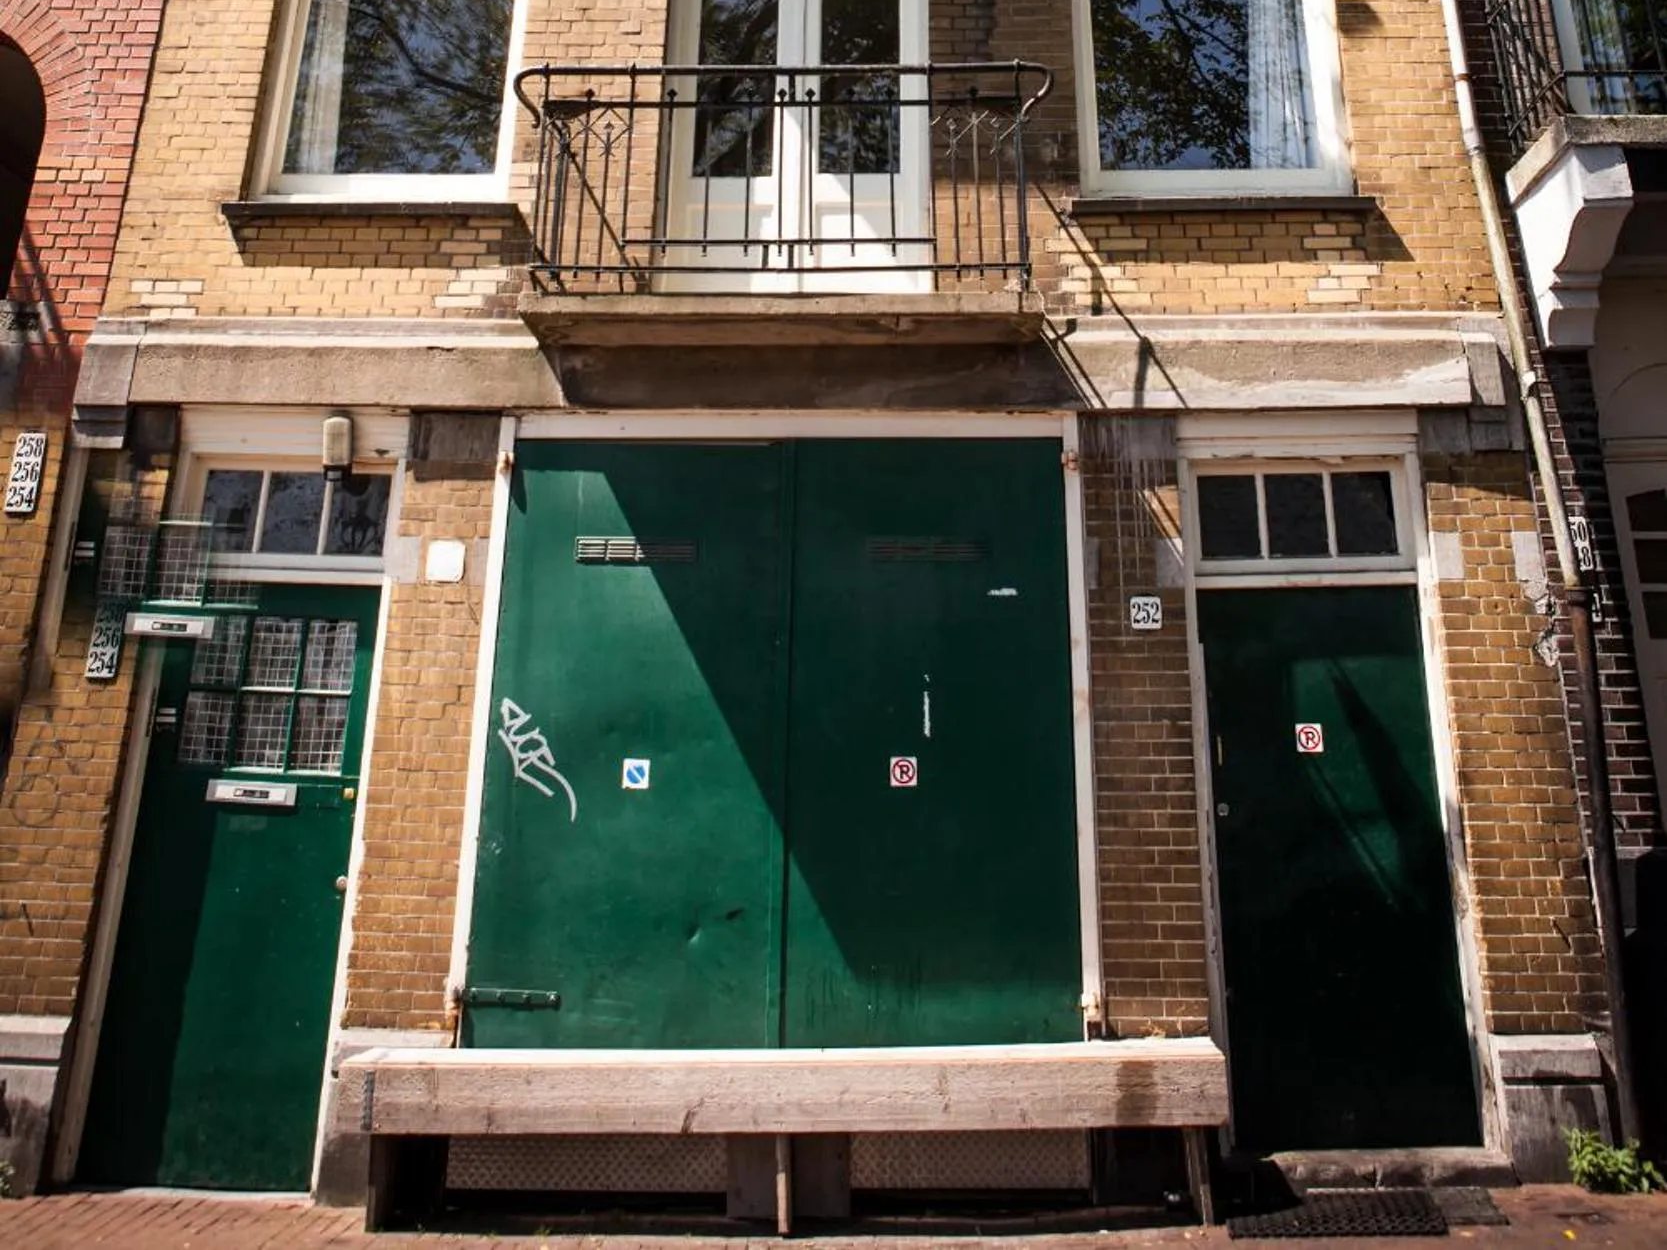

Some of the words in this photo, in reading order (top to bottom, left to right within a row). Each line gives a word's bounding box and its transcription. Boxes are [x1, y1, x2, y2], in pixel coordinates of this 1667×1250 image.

[16, 436, 43, 458] 258
[11, 461, 39, 482] 256
[6, 486, 34, 508] 254
[1132, 601, 1160, 624] 252
[92, 626, 121, 647] 256
[87, 651, 116, 674] 254
